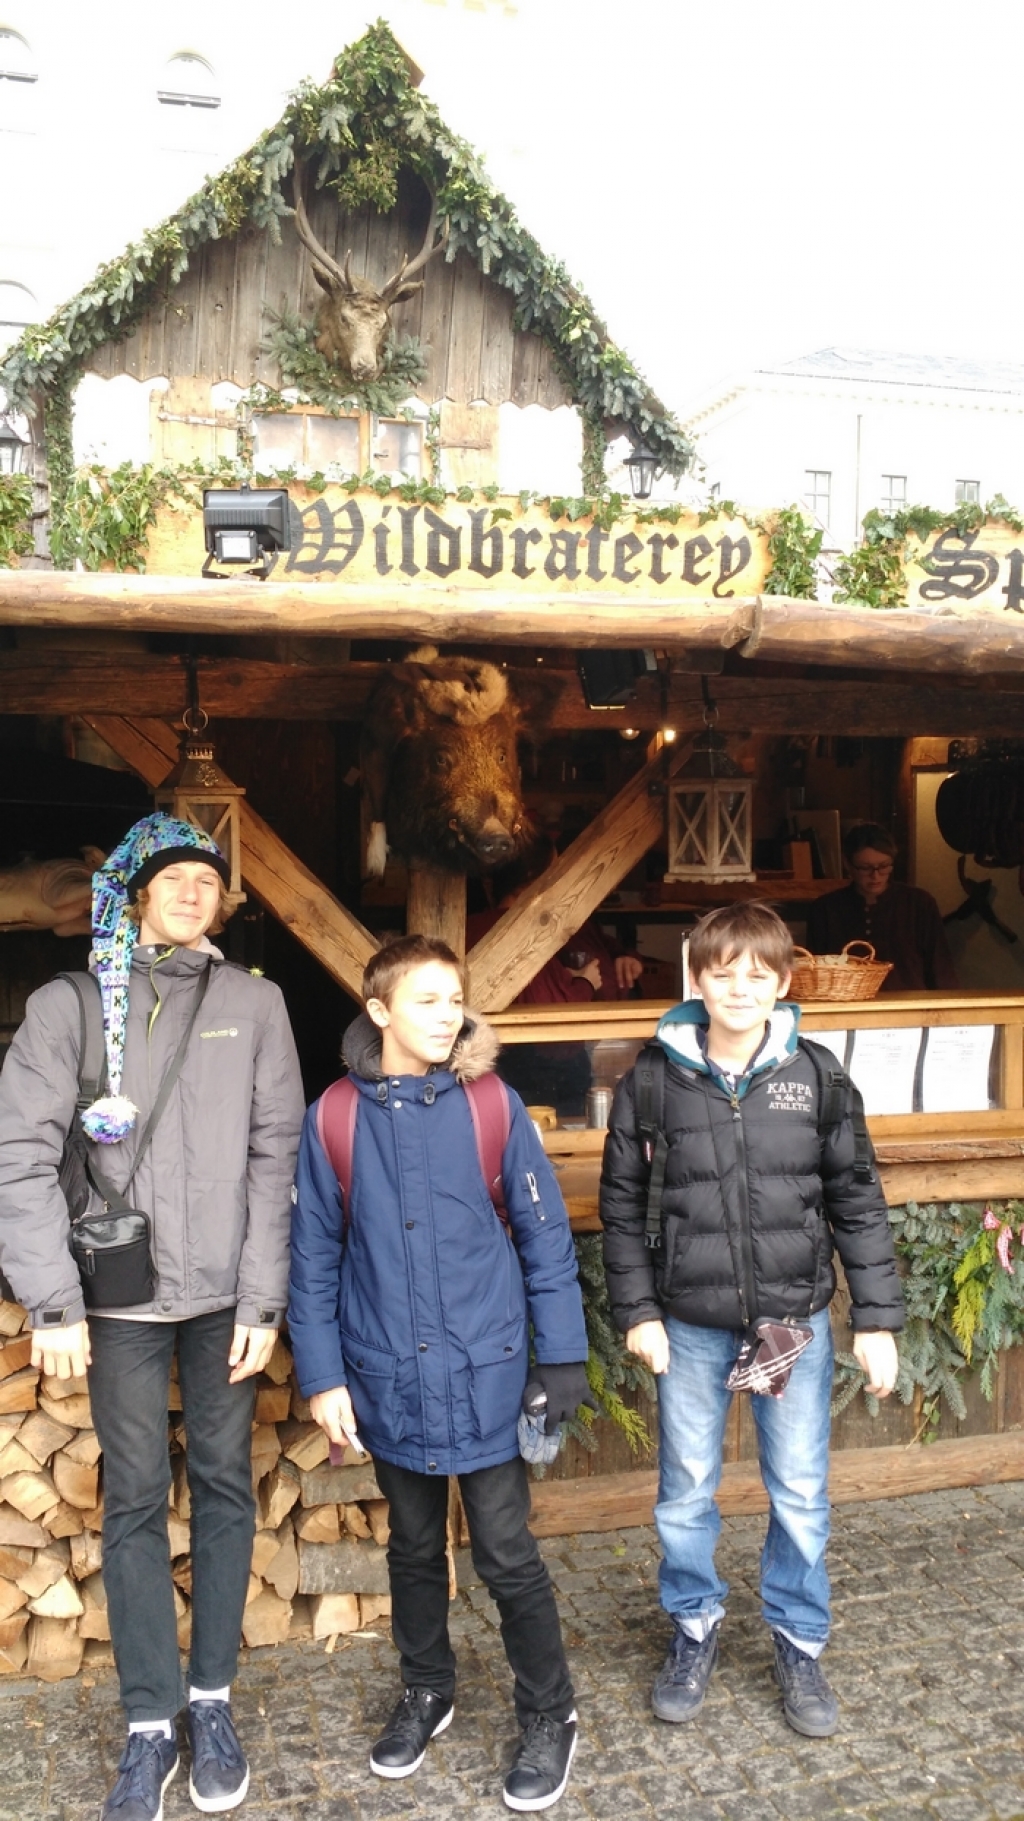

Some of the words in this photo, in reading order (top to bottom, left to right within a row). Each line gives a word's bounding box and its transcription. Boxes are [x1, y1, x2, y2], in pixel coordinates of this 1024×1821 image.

[284, 497, 752, 598] Wildbraterey
[766, 1082, 813, 1098] KAPPA
[768, 1101, 811, 1112] ATHLETIC
